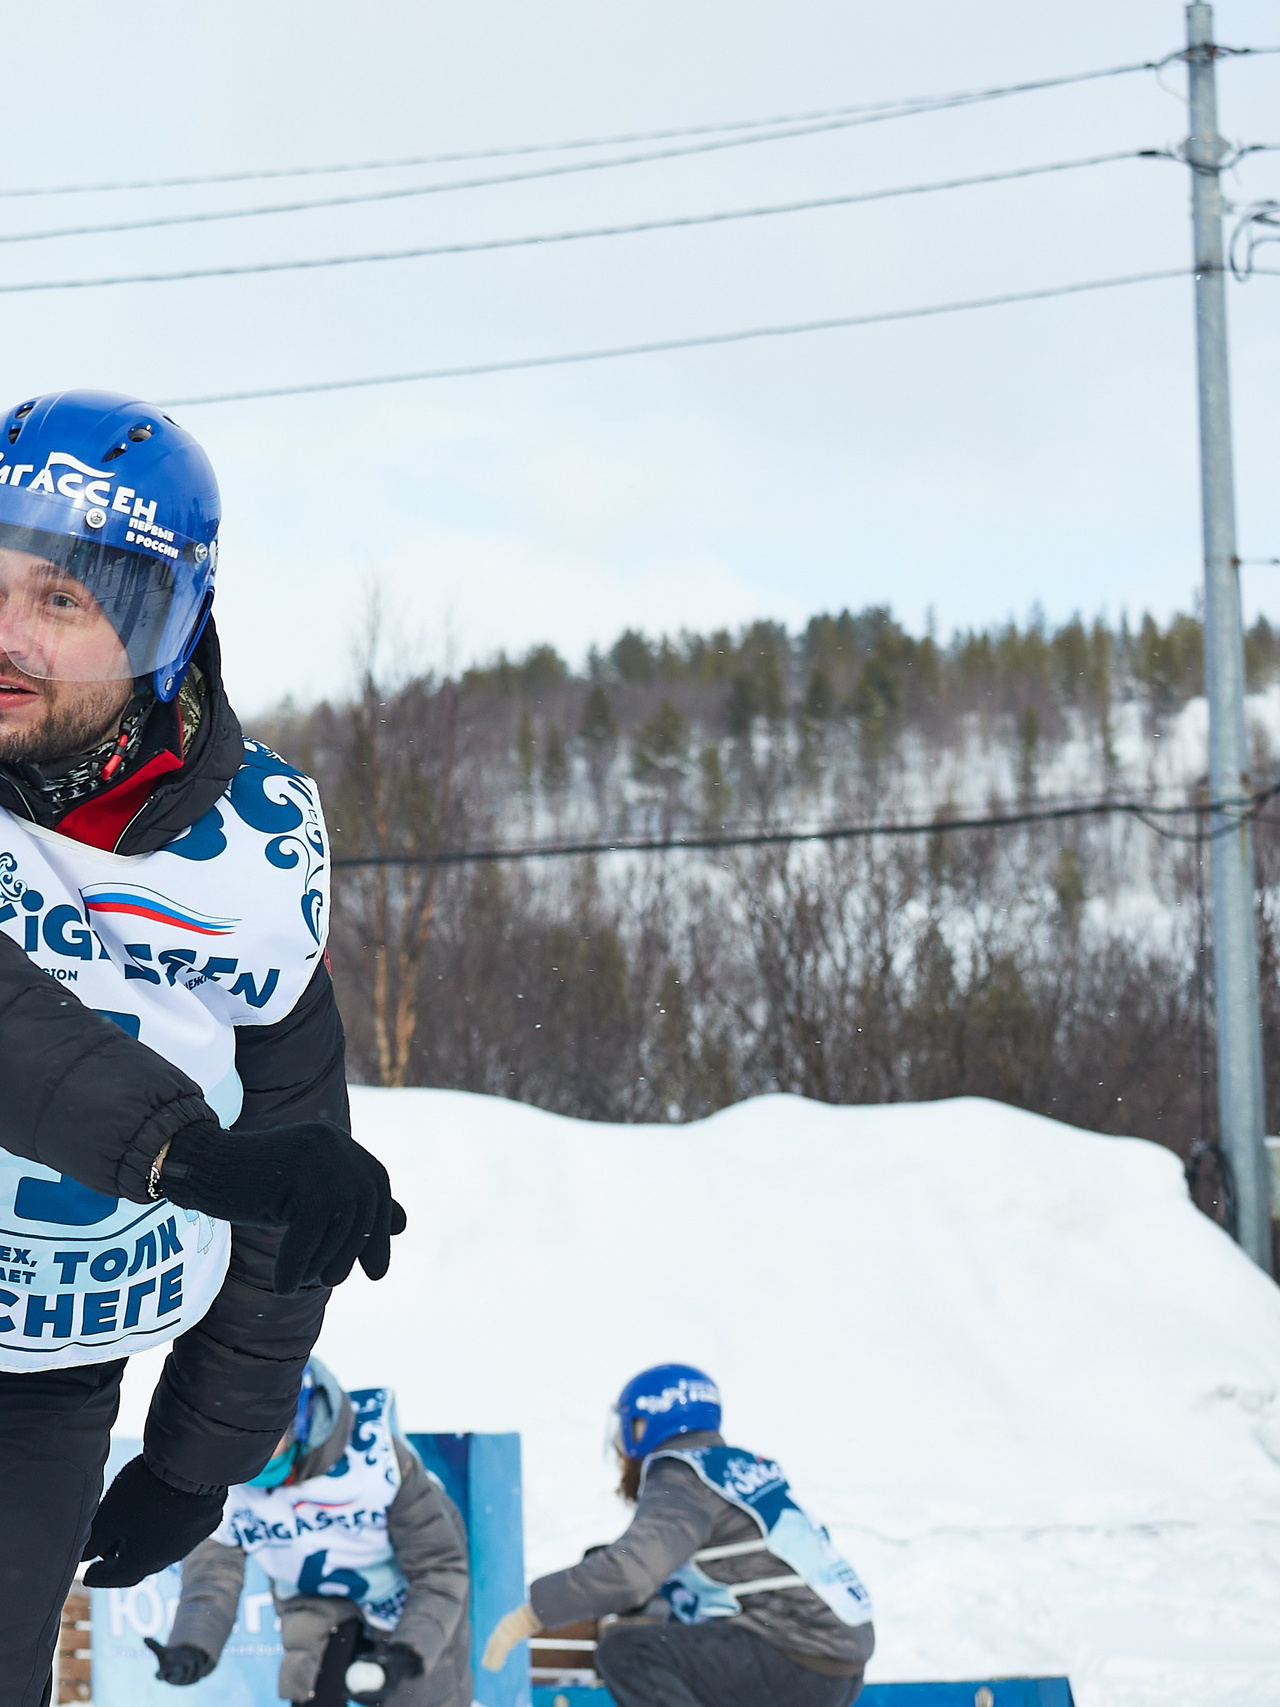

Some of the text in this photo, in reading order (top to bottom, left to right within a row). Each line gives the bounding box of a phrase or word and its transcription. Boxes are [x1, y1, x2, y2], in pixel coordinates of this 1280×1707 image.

[128, 517, 175, 543] ПЕРВЫЕ
[125, 531, 180, 560] В РОССИИ
[53, 1215, 184, 1285] ТОЛК
